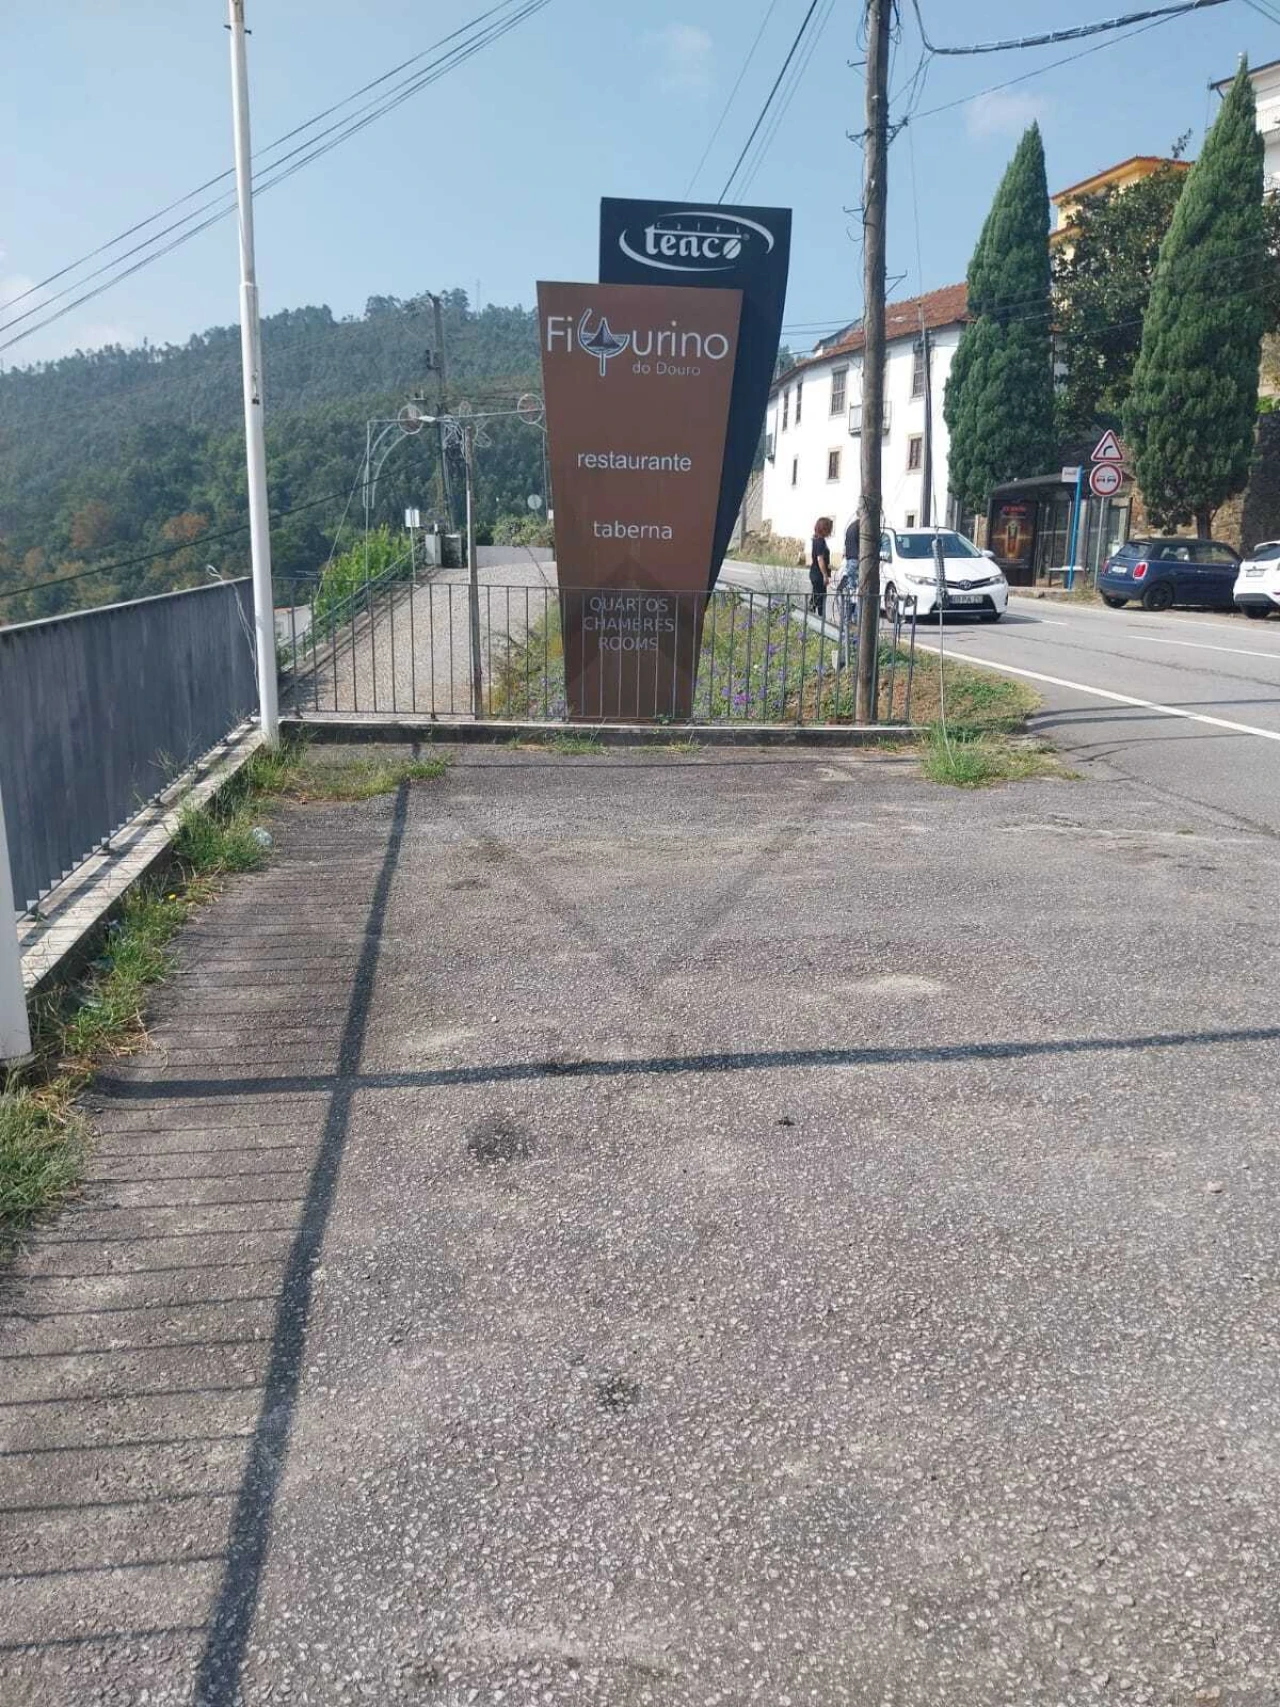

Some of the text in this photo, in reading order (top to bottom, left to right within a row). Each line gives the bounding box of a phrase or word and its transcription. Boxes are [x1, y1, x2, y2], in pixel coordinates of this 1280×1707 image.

[632, 361, 701, 377] do Douro
[577, 450, 692, 472] restaurante
[593, 520, 673, 540] taberna
[589, 597, 669, 613] QUARTOS
[583, 616, 675, 632] CHAMBRES
[598, 636, 658, 651] ROOMS
